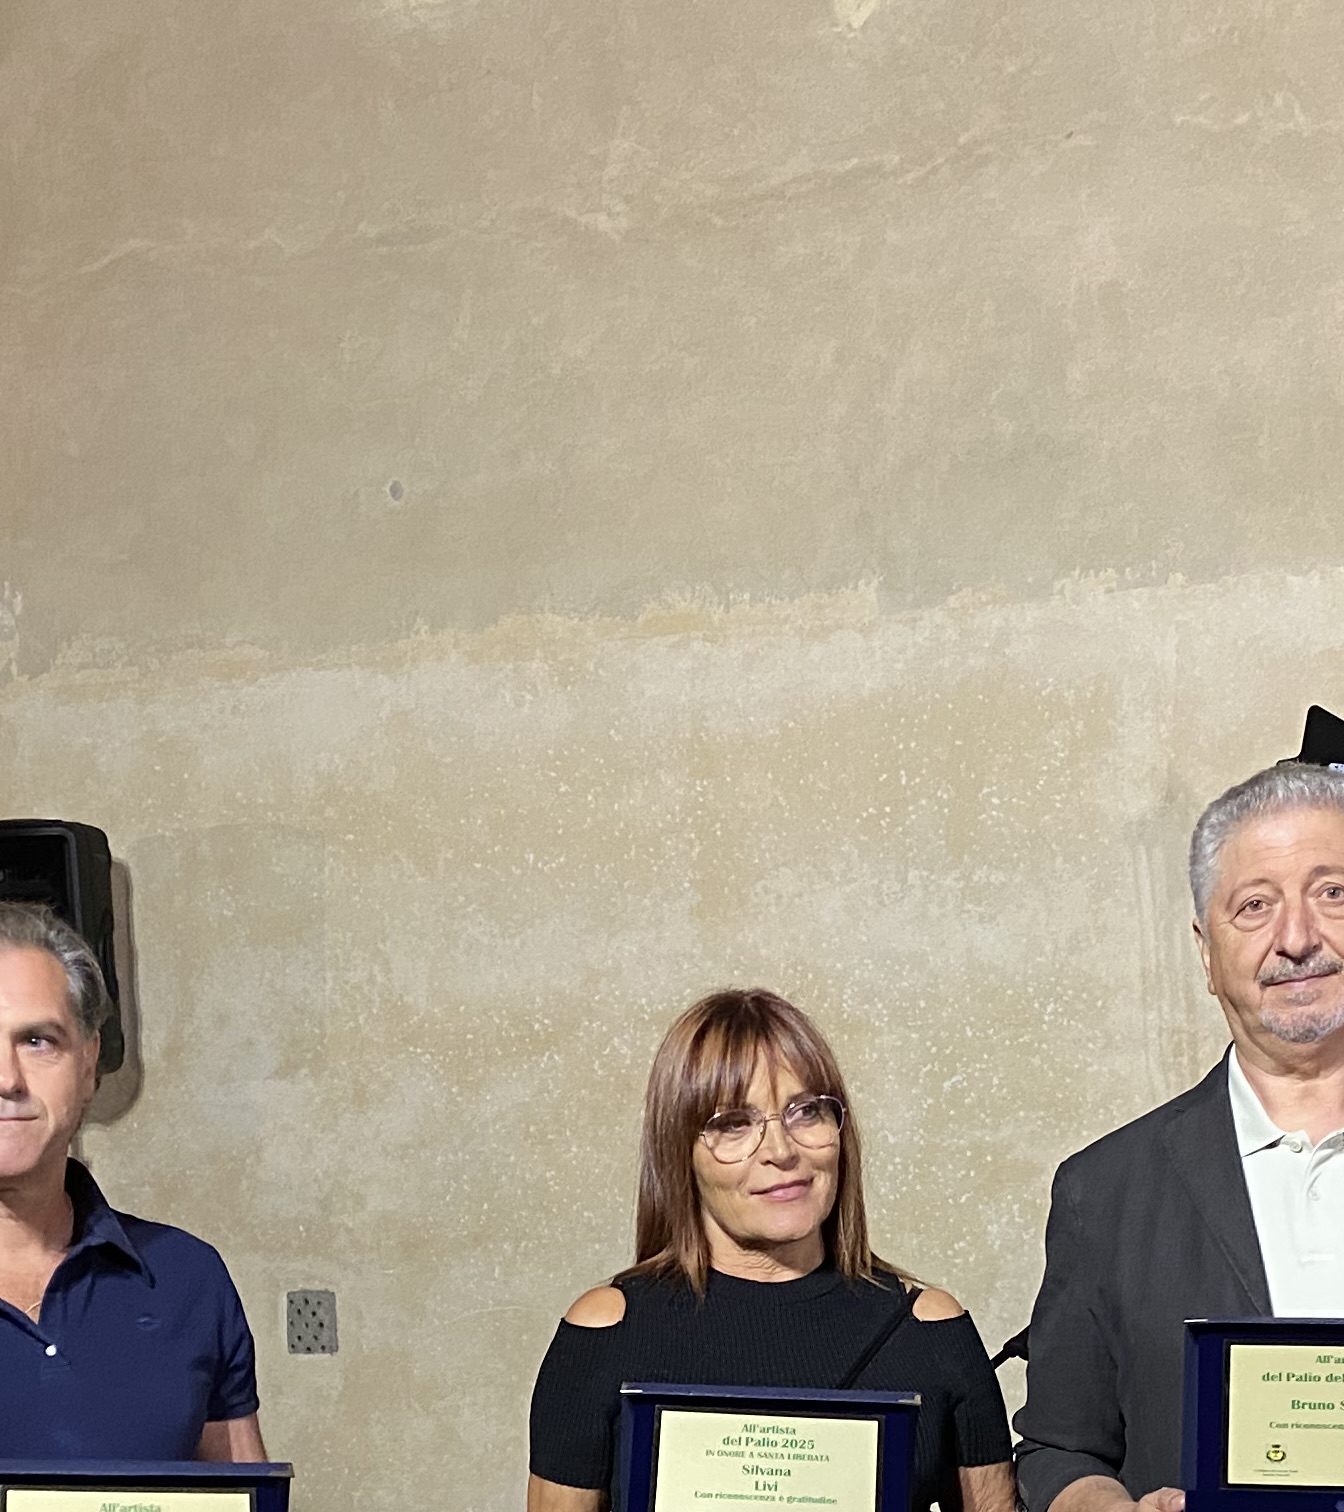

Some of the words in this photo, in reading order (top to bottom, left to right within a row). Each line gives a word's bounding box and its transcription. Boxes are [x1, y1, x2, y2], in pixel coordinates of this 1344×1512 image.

[1261, 1372, 1282, 1382] del
[1286, 1372, 1321, 1383] Palio
[1291, 1399, 1335, 1411] Bruno
[741, 1424, 796, 1435] All'artista
[1269, 1421, 1289, 1429] Con
[722, 1436, 742, 1446] del
[745, 1437, 778, 1448] Palio
[781, 1439, 815, 1449] 2025
[741, 1464, 791, 1477] Silvana
[754, 1480, 778, 1491] Livi
[99, 1503, 162, 1512] All'artista
